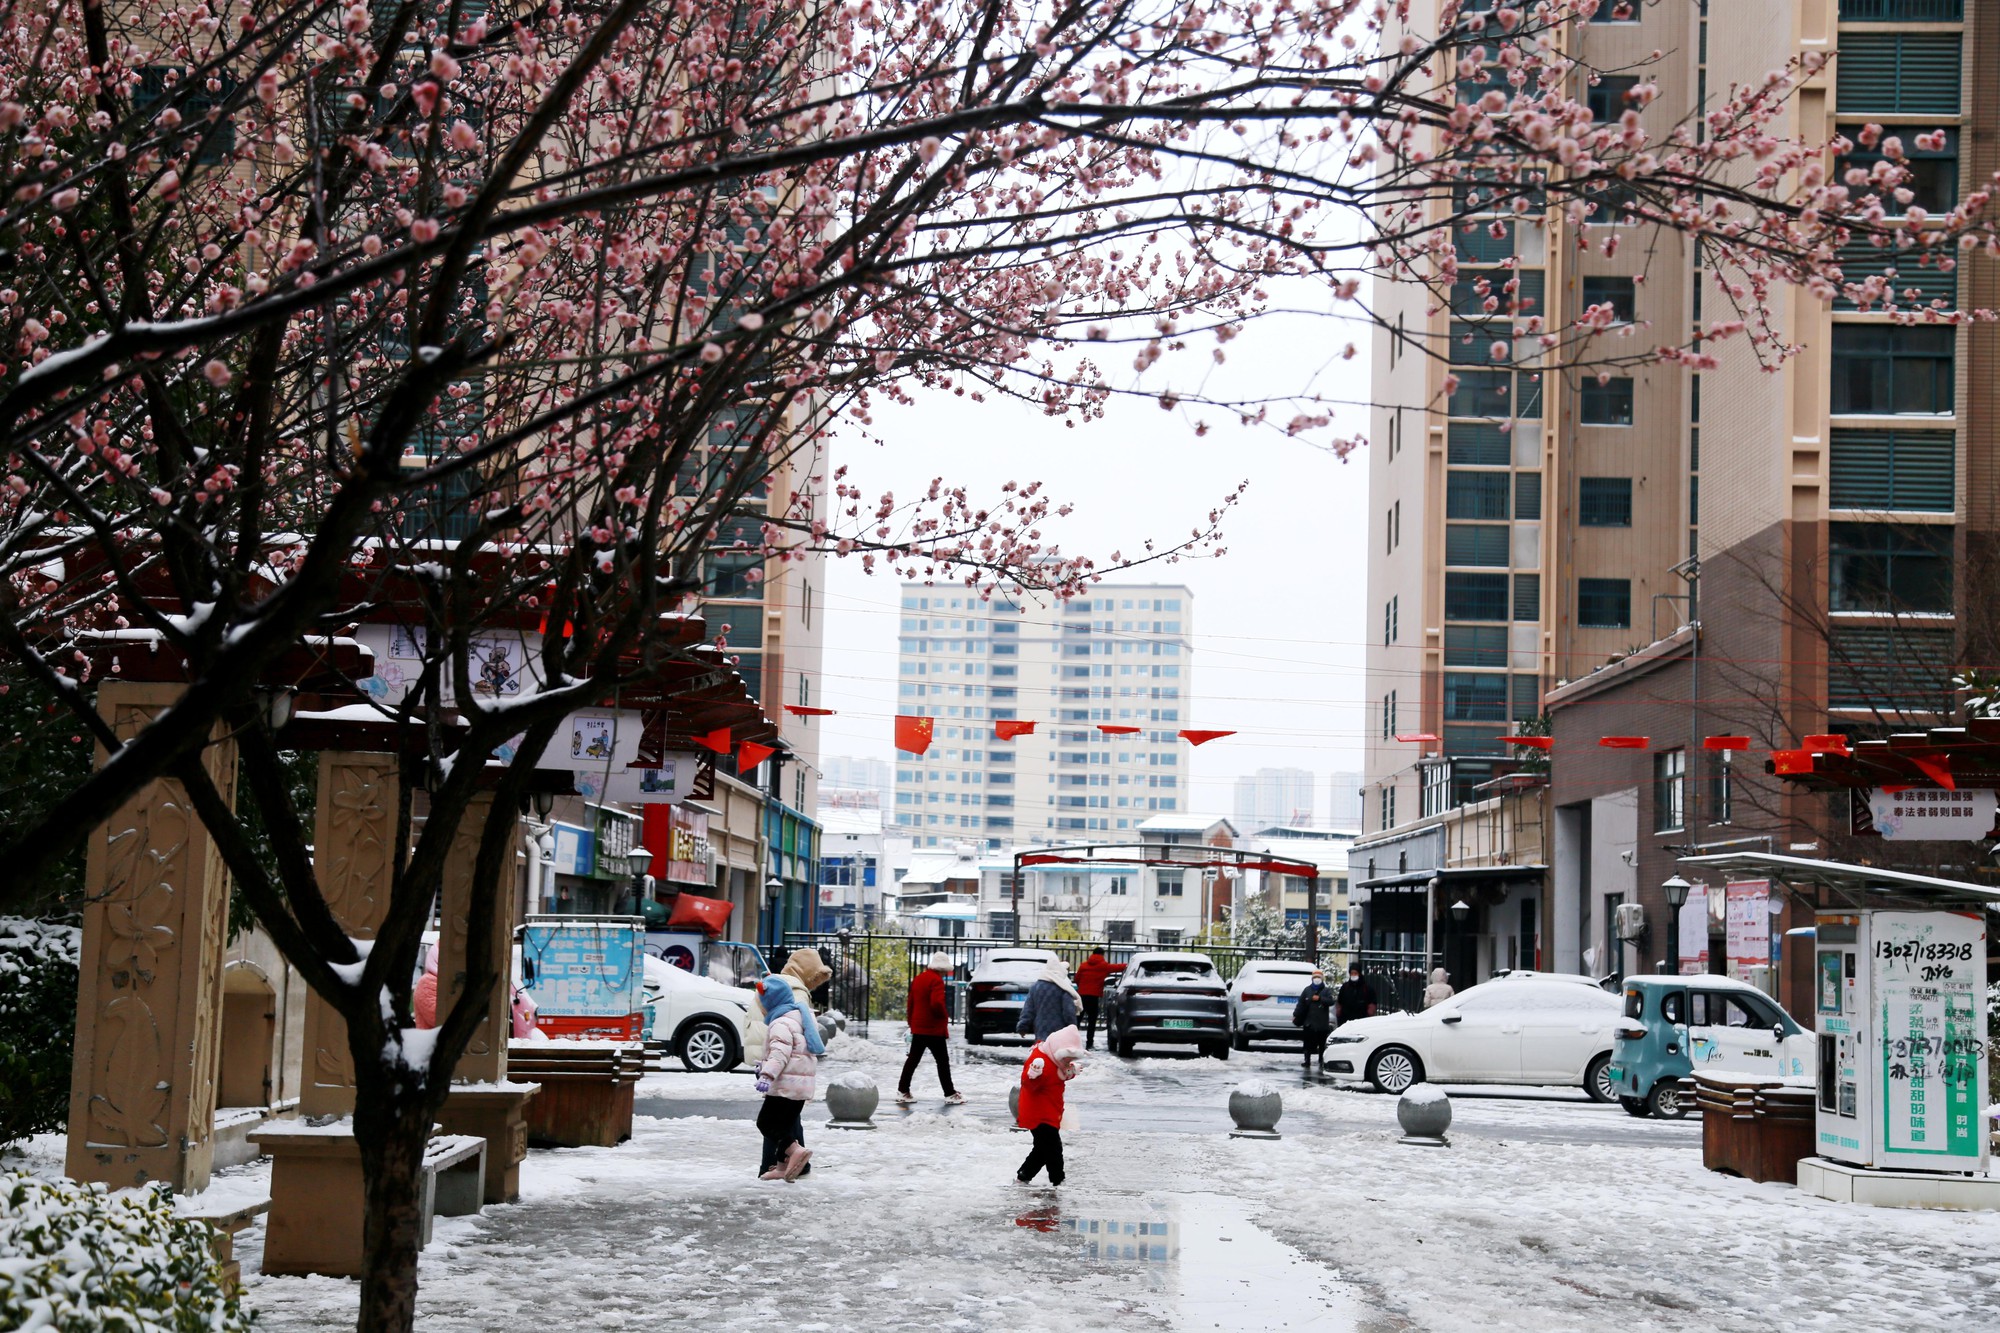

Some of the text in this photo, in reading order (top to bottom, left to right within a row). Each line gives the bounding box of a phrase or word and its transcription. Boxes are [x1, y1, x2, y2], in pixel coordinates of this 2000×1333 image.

[1893, 791, 1973, 802] 奉法者强则国强
[1893, 807, 1973, 817] 奉法者弱则国弱
[1876, 940, 1973, 963] 13027183318
[1956, 1115, 1967, 1137] 时尚
